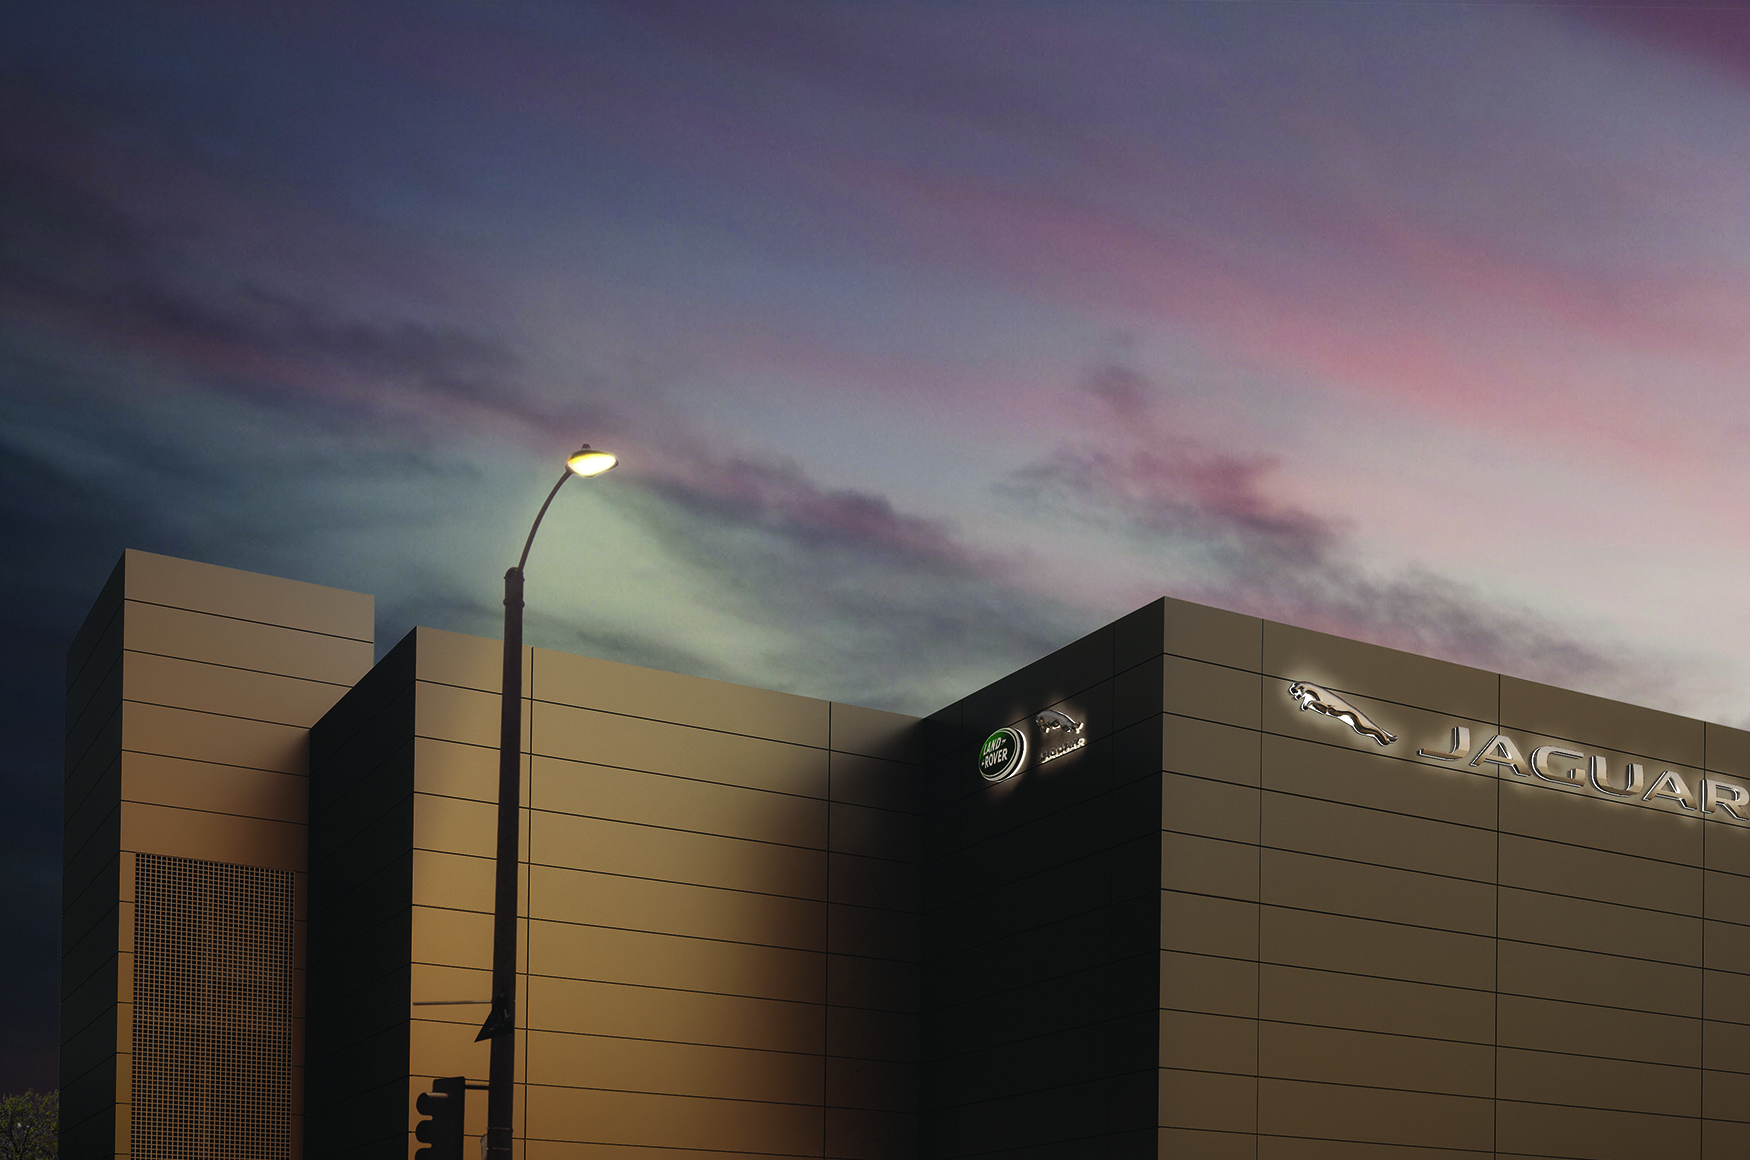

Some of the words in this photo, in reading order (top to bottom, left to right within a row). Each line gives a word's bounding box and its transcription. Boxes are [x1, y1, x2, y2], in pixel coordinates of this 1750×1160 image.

[983, 737, 1002, 756] LAND
[984, 747, 1009, 769] ROVER
[1419, 727, 1750, 821] JAGUAR
